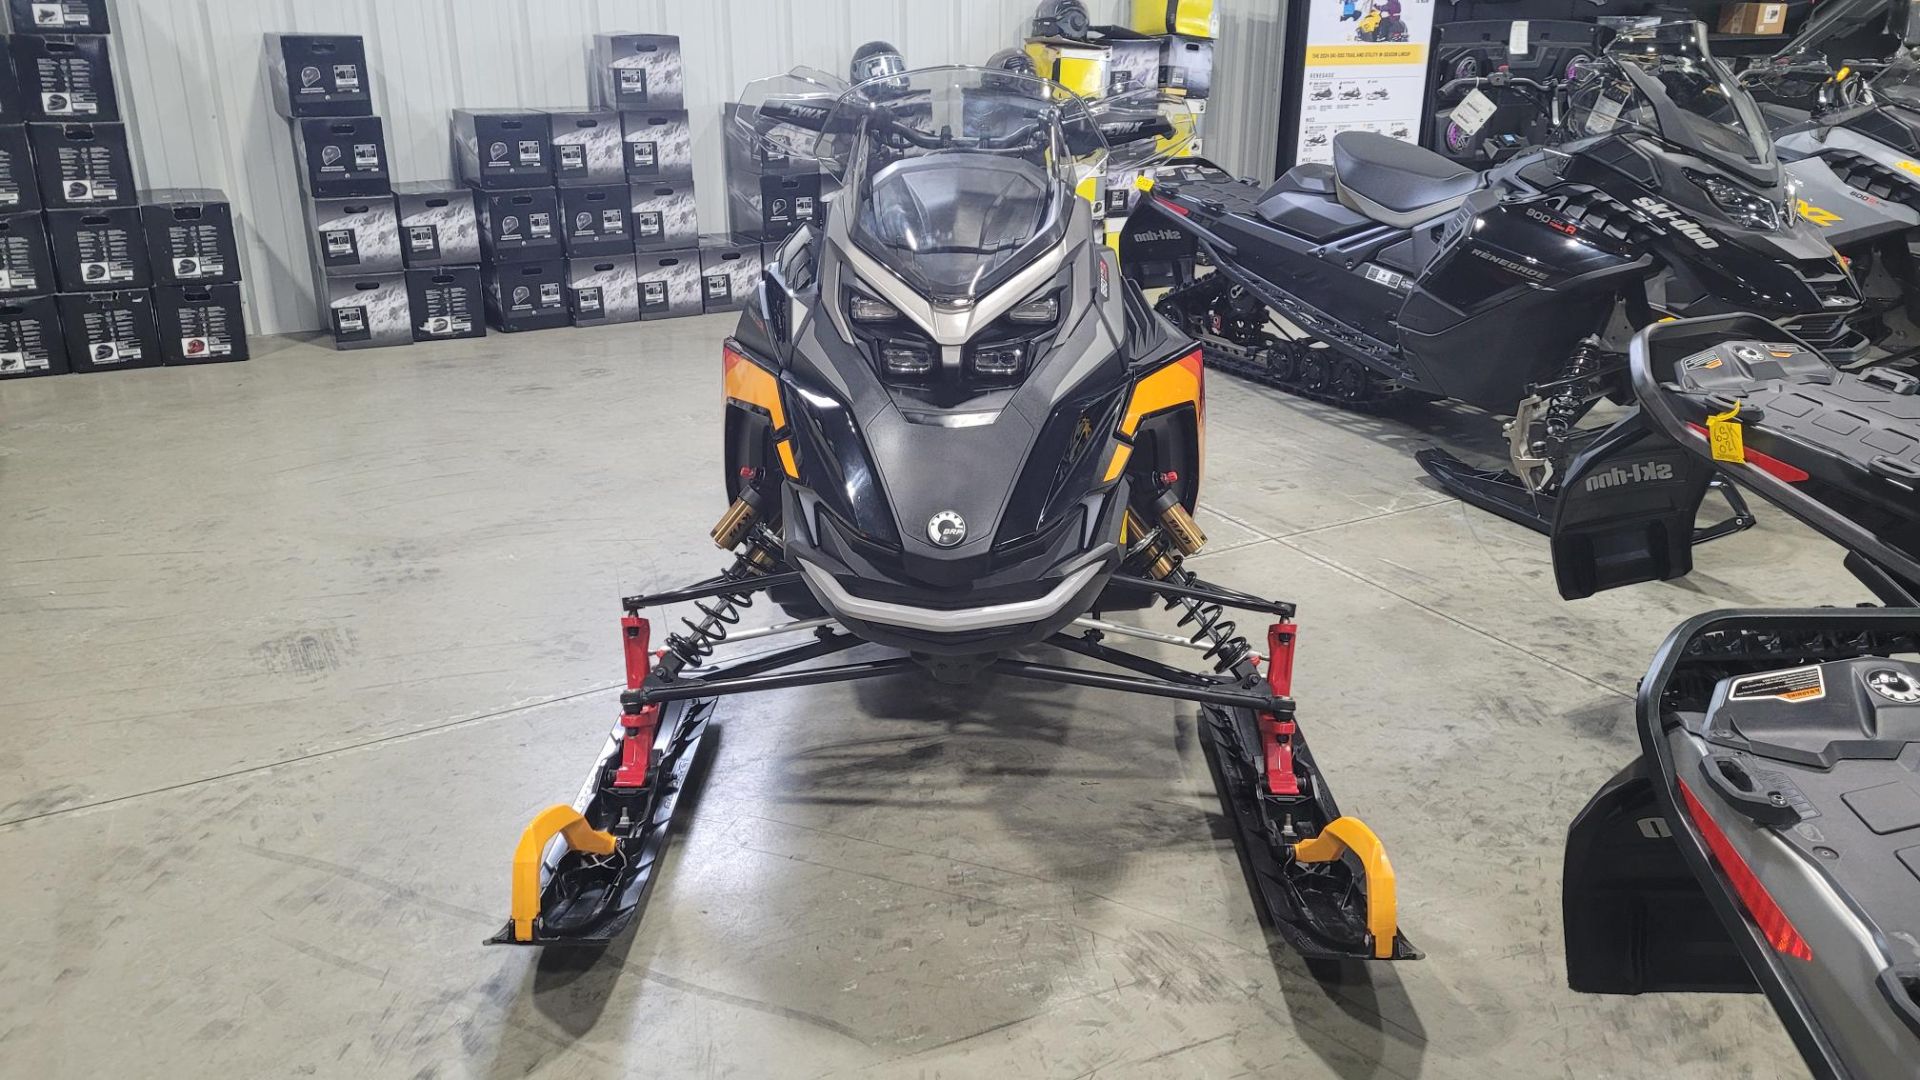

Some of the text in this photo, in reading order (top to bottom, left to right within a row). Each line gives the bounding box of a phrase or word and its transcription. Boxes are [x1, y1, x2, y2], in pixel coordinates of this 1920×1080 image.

[1526, 208, 1551, 223] 900
[1631, 196, 1719, 250] ski-doo
[1471, 247, 1550, 280] RENEGADE
[942, 528, 965, 536] BRP
[1871, 676, 1899, 685] BRP
